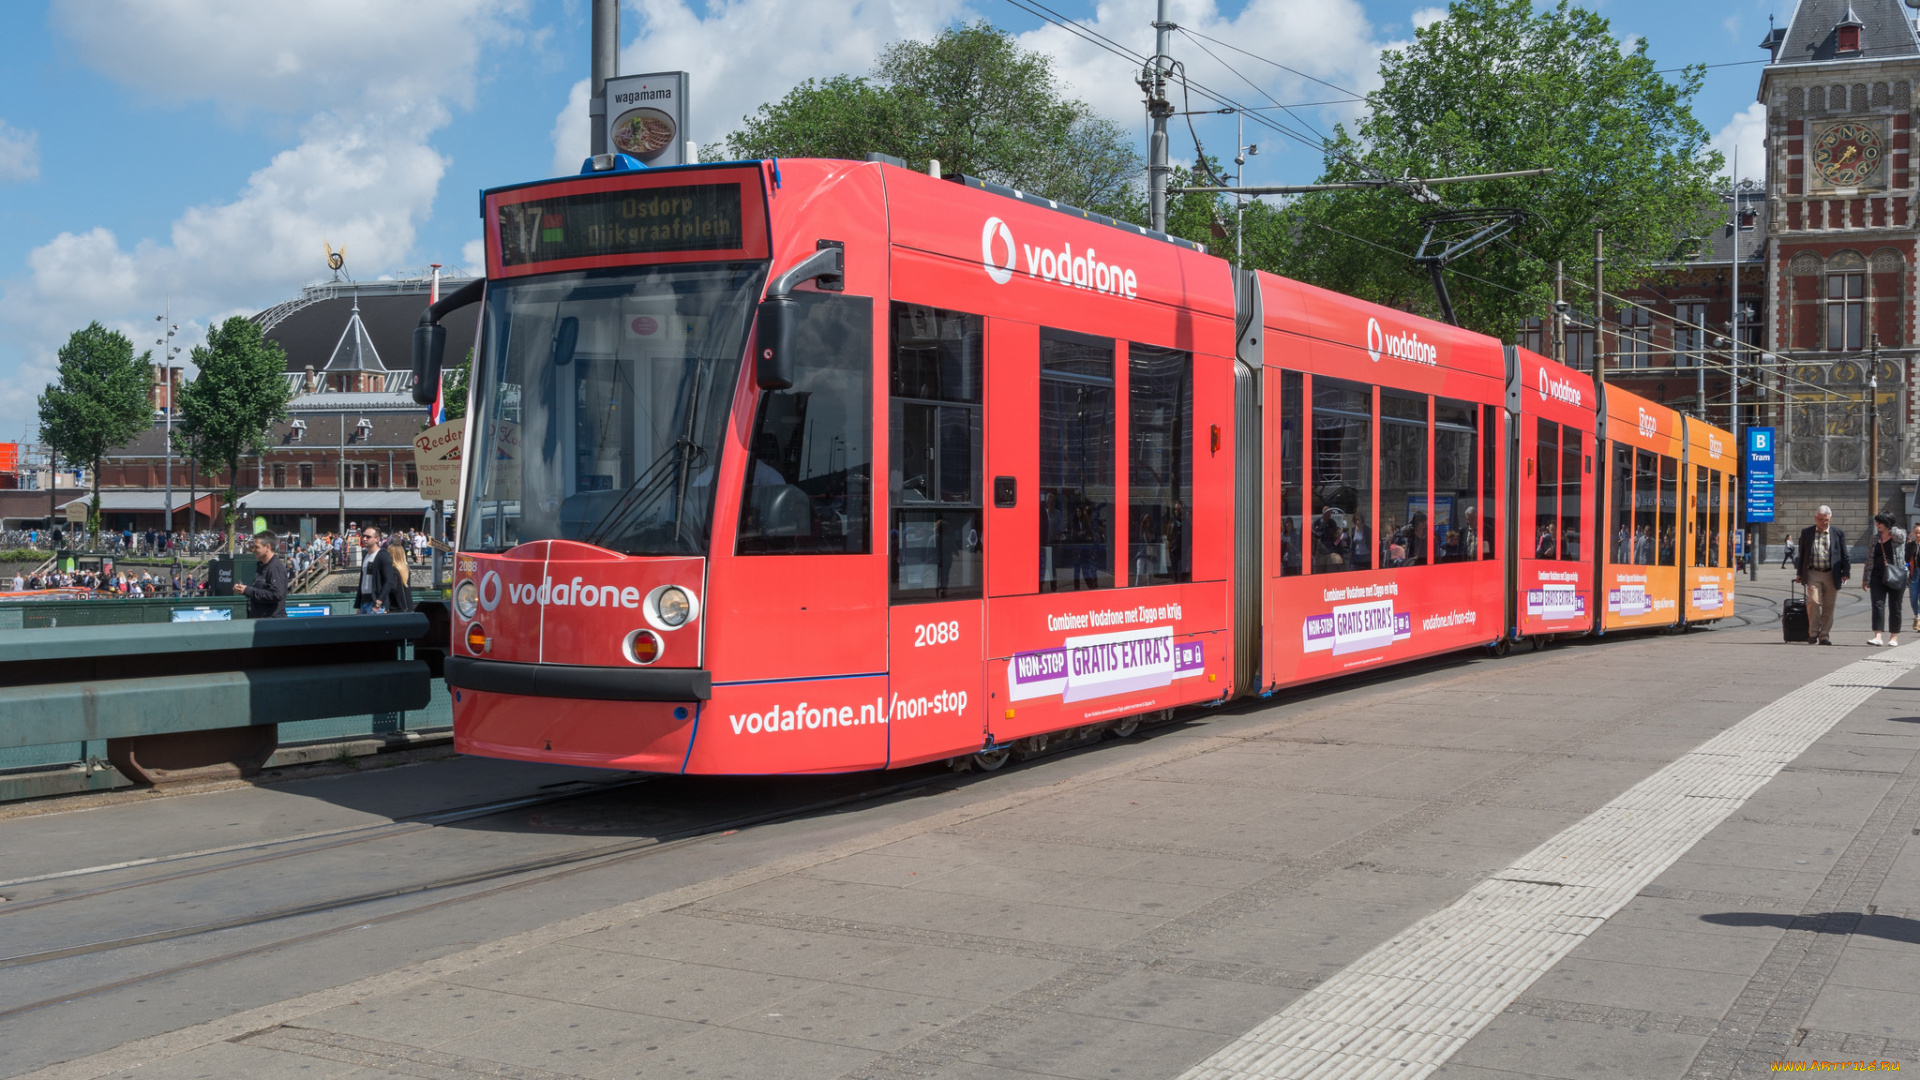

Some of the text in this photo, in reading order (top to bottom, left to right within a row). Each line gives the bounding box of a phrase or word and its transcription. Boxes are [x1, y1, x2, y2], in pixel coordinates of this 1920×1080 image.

[615, 89, 671, 104] wagamama
[1843, 127, 1853, 138] N
[514, 206, 543, 253] 17
[588, 214, 730, 246] Dijkgraafplein
[1023, 242, 1137, 300] vodafone
[1385, 331, 1437, 367] vodafone
[1550, 378, 1581, 407] vodafone
[416, 427, 463, 454] Reeder
[1756, 434, 1766, 449] B
[420, 464, 451, 472] ROUNDTRIP
[1751, 453, 1771, 462] Tram
[458, 561, 478, 573] 2088
[508, 576, 640, 609] vodafone
[1047, 603, 1182, 632] Combineer Vodafone met Ziggo en krijg
[1337, 610, 1363, 636] GRATIS
[1364, 606, 1392, 632] EXTRA'S
[1422, 609, 1477, 631] vodafone.nl/non-stop
[914, 620, 960, 648] 2088
[1018, 635, 1170, 679] NON-STOP GRATIS EXTRA'S
[729, 689, 968, 735] vodafone.nl/non-stop
